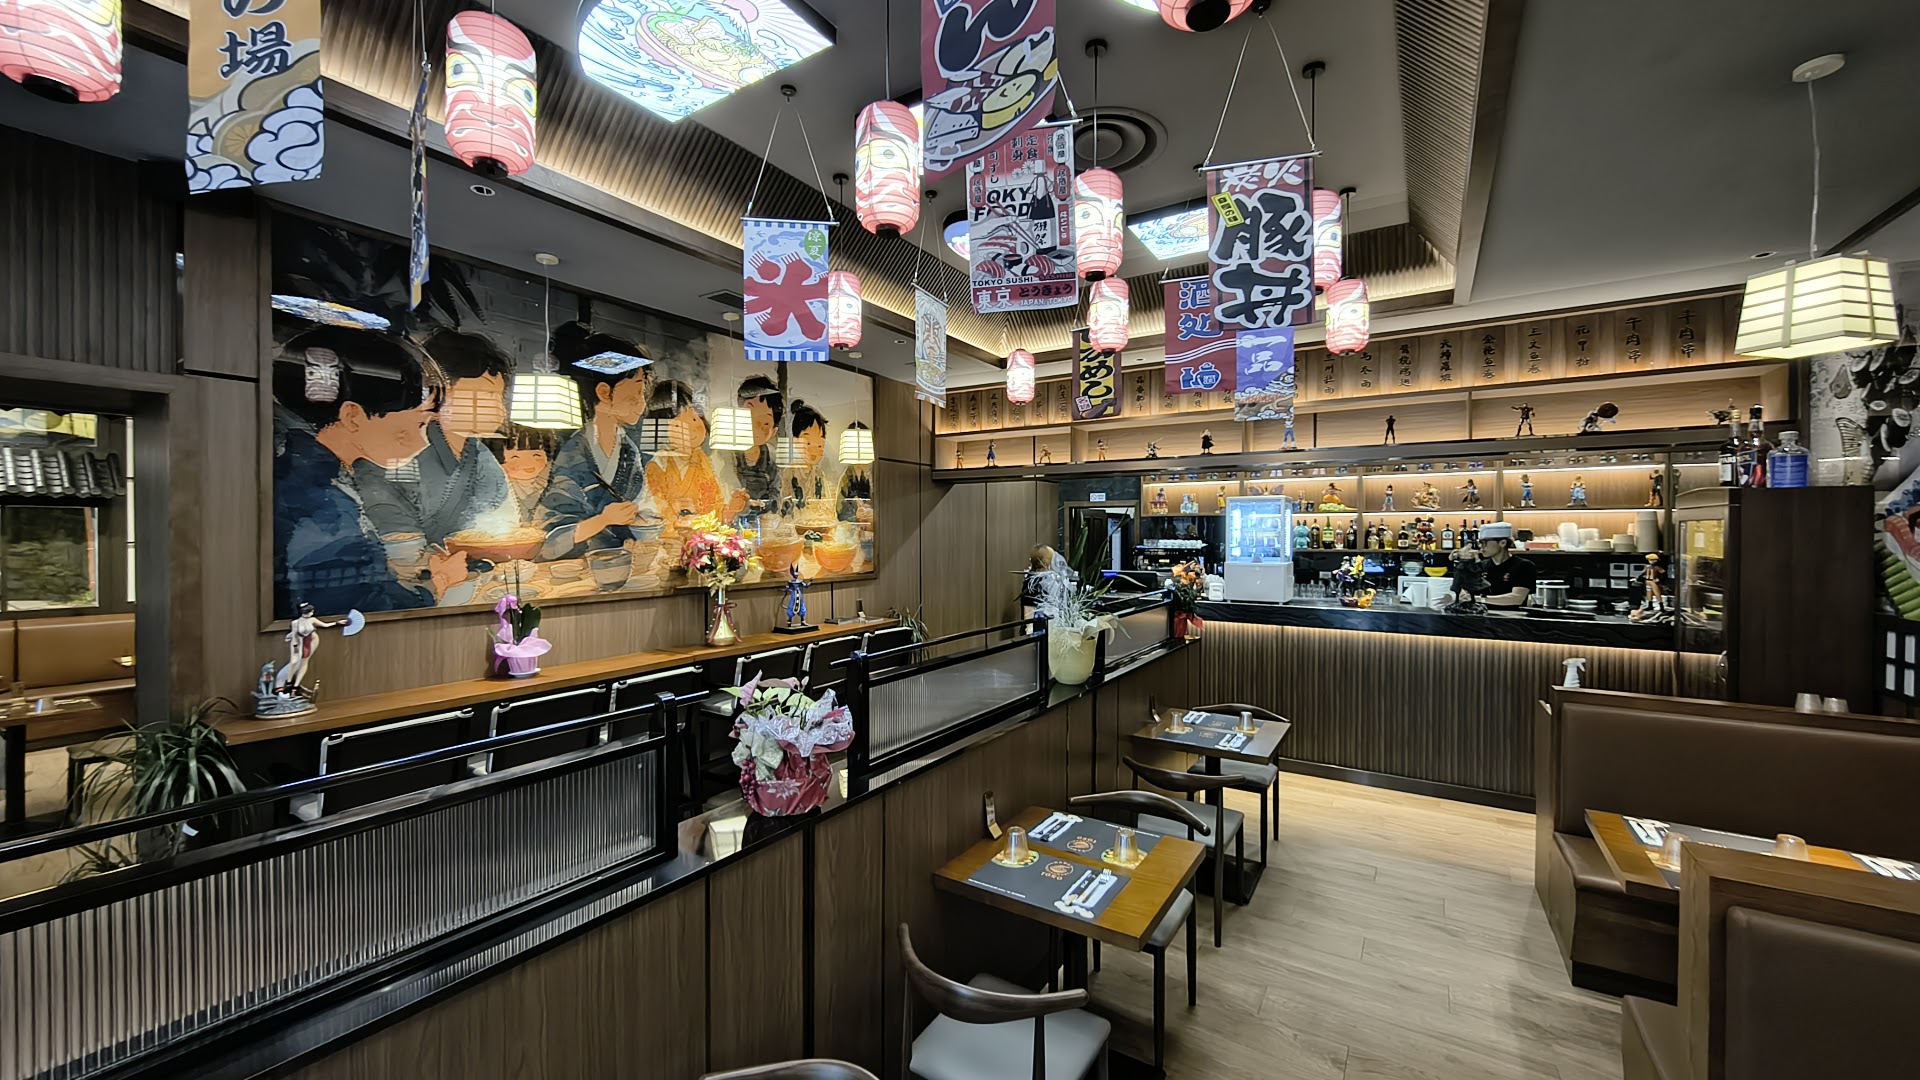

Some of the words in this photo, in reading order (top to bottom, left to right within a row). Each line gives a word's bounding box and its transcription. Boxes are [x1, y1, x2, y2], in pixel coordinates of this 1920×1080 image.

[972, 278, 1003, 287] TOKYO
[1005, 276, 1033, 284] SUSHI
[1019, 283, 1073, 298] とうきょう
[976, 287, 1012, 310] 東京
[1020, 299, 1045, 308] JAPAN
[1049, 296, 1074, 305] TOKYO
